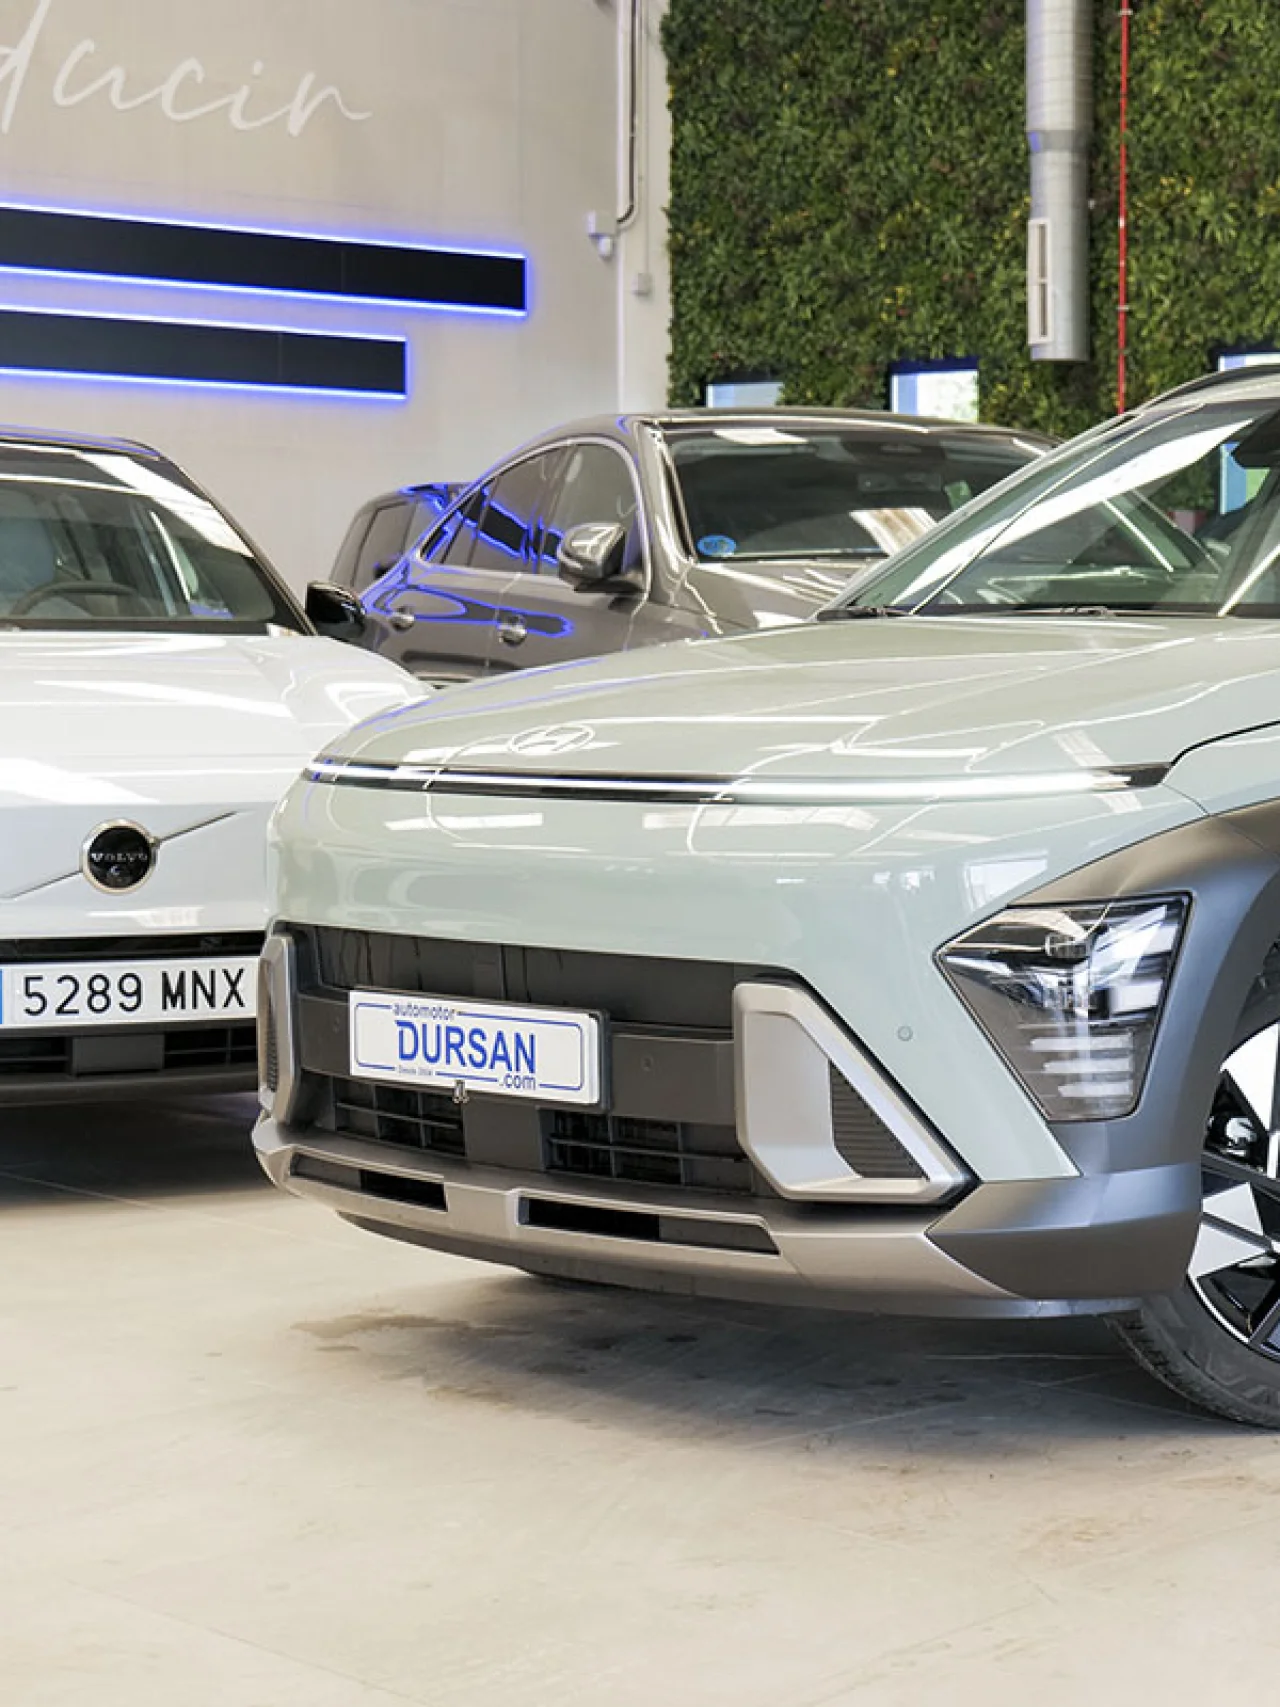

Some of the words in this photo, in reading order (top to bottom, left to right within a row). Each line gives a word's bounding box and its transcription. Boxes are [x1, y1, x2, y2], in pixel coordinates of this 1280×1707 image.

[91, 852, 148, 863] VOLVO
[24, 972, 143, 1016] 5289
[161, 968, 245, 1011] MNX
[393, 1003, 456, 1021] automotor
[394, 1019, 536, 1074] DURSAN
[499, 1074, 537, 1091] .com
